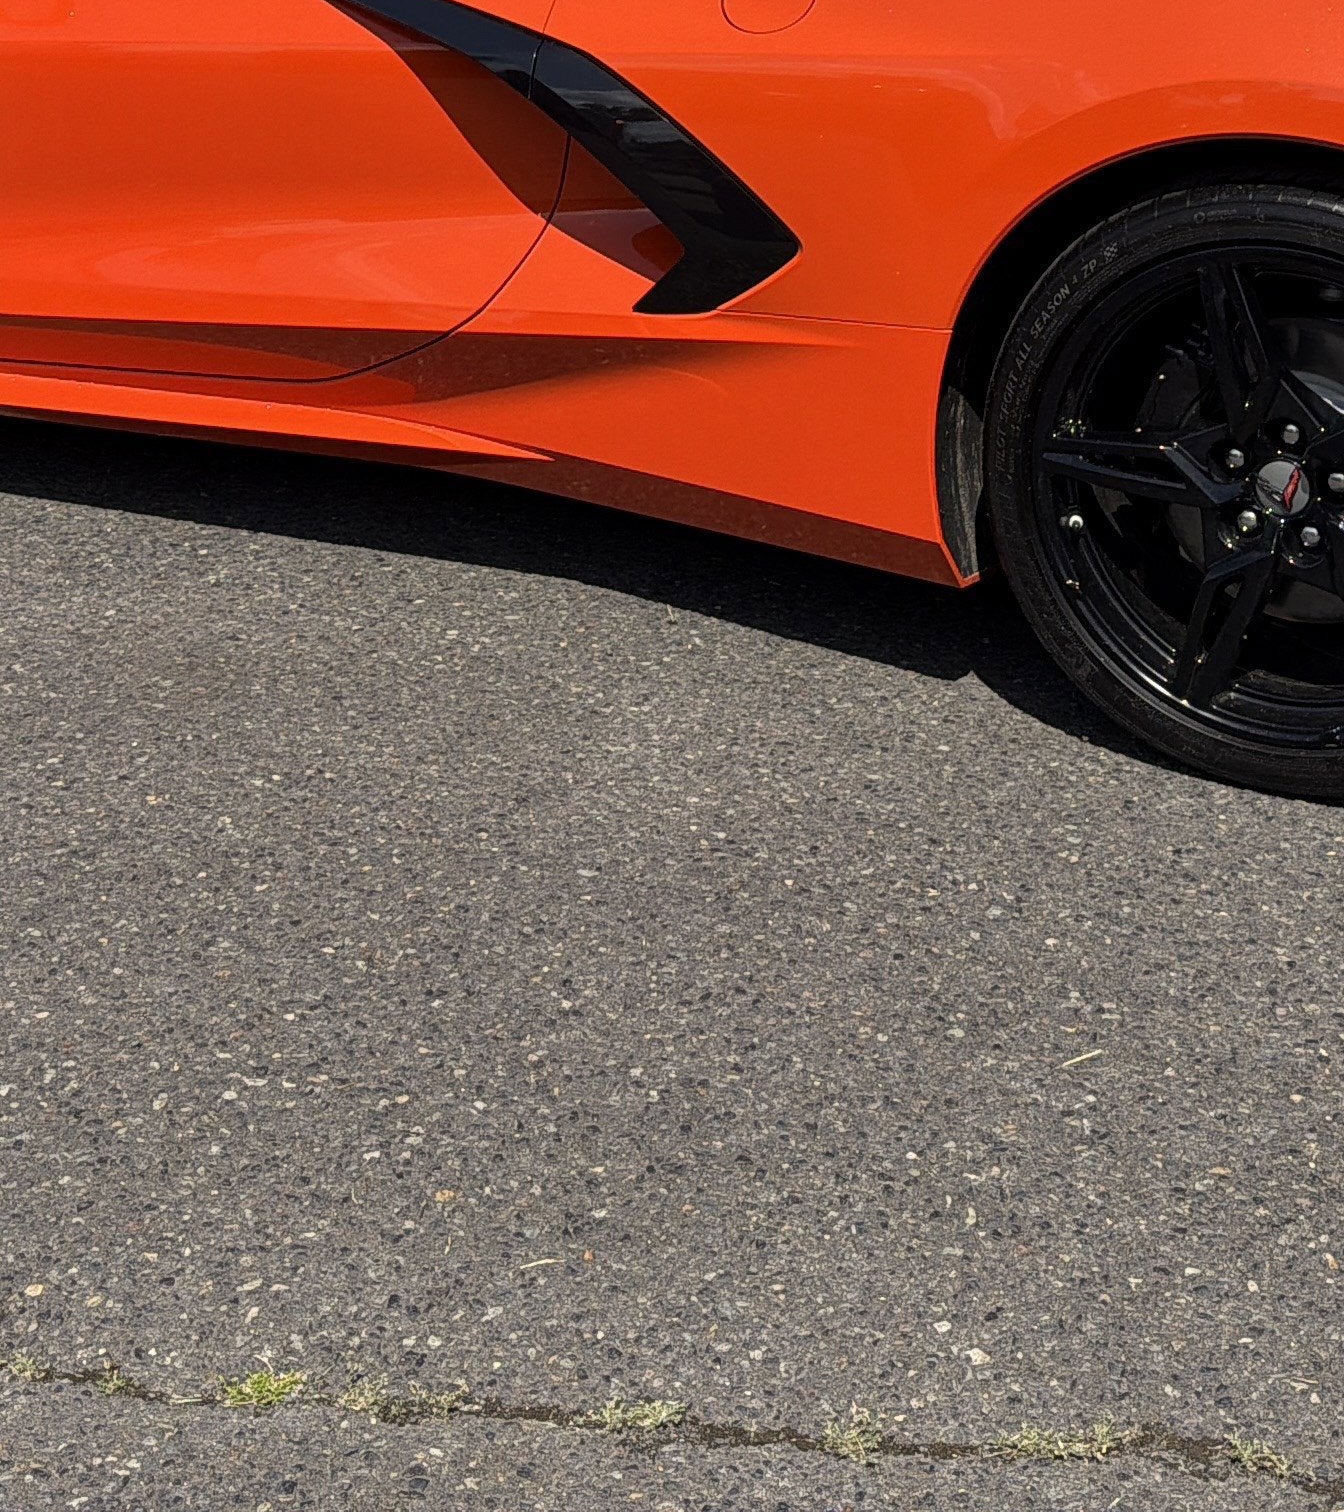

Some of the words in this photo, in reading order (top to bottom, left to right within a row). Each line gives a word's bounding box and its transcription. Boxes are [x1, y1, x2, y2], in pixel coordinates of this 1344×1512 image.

[1014, 341, 1032, 371] ALL
[1029, 284, 1071, 339] SEASON
[1081, 258, 1098, 281] ZP
